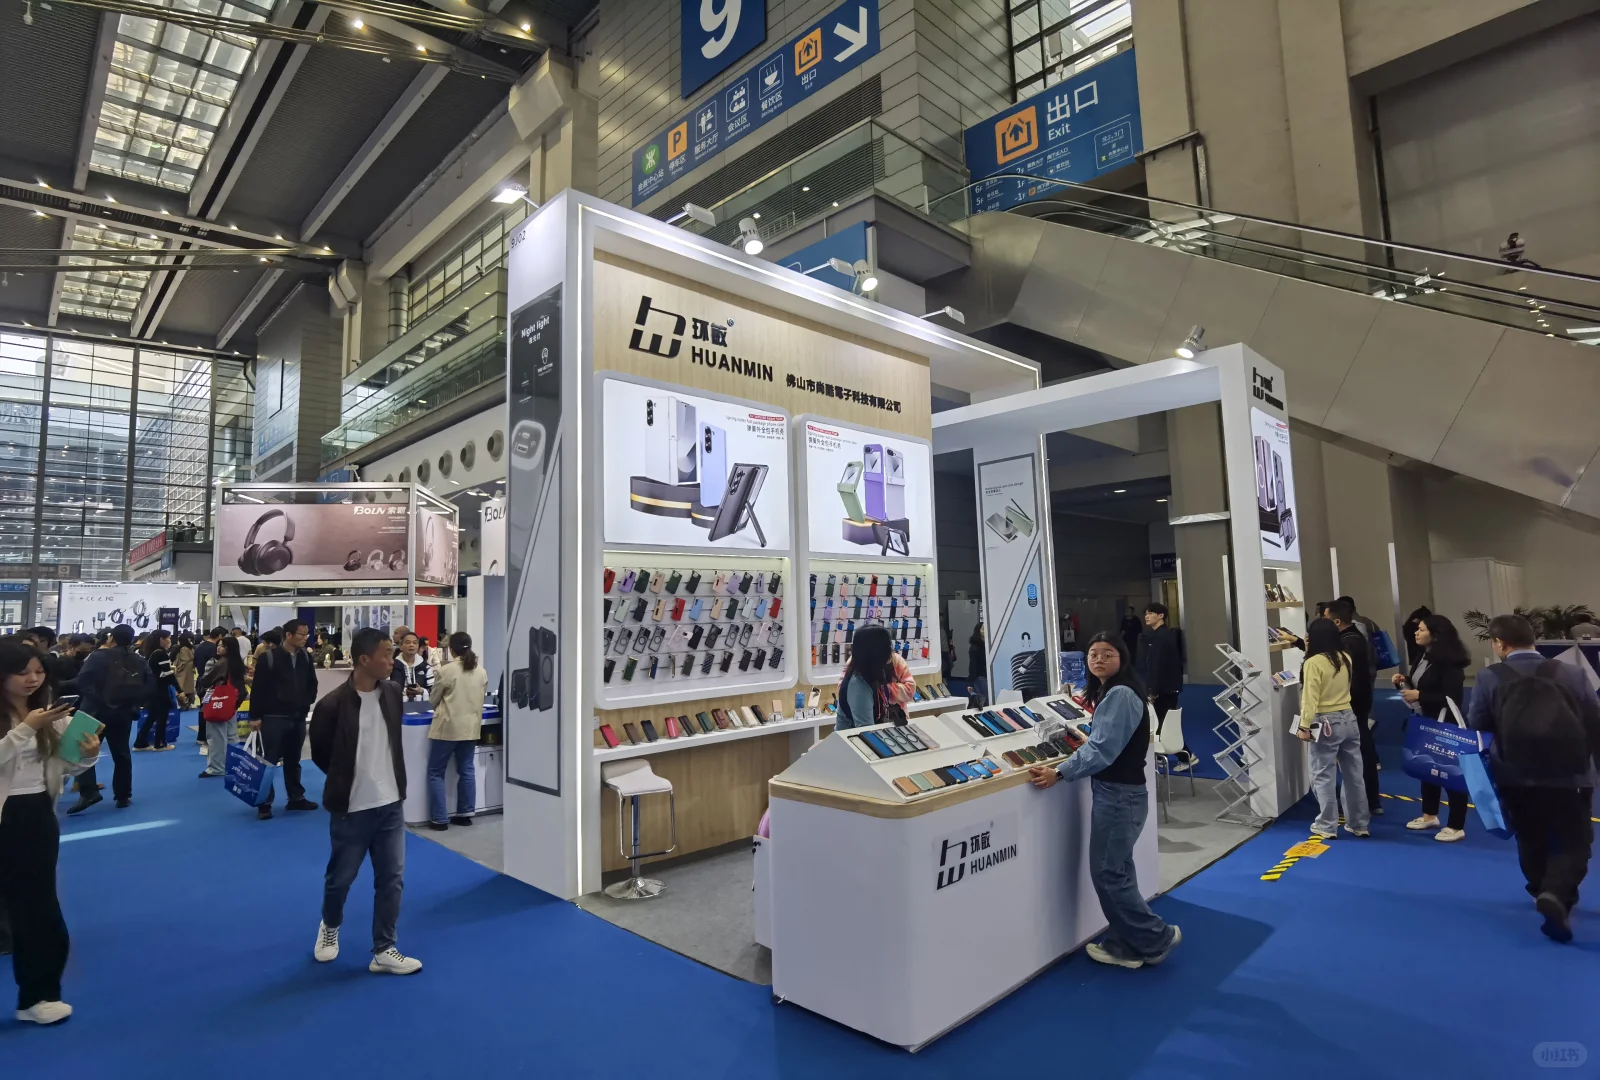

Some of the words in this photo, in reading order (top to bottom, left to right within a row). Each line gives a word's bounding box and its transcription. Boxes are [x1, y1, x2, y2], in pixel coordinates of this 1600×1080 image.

[802, 69, 816, 85] 出口
[1047, 81, 1099, 125] 出口
[728, 113, 748, 132] 会议区
[1048, 123, 1071, 141] Exit
[521, 323, 536, 339] Night
[536, 315, 550, 330] light
[691, 346, 773, 382] HUANMIN
[970, 843, 1017, 875] HUANMIN
